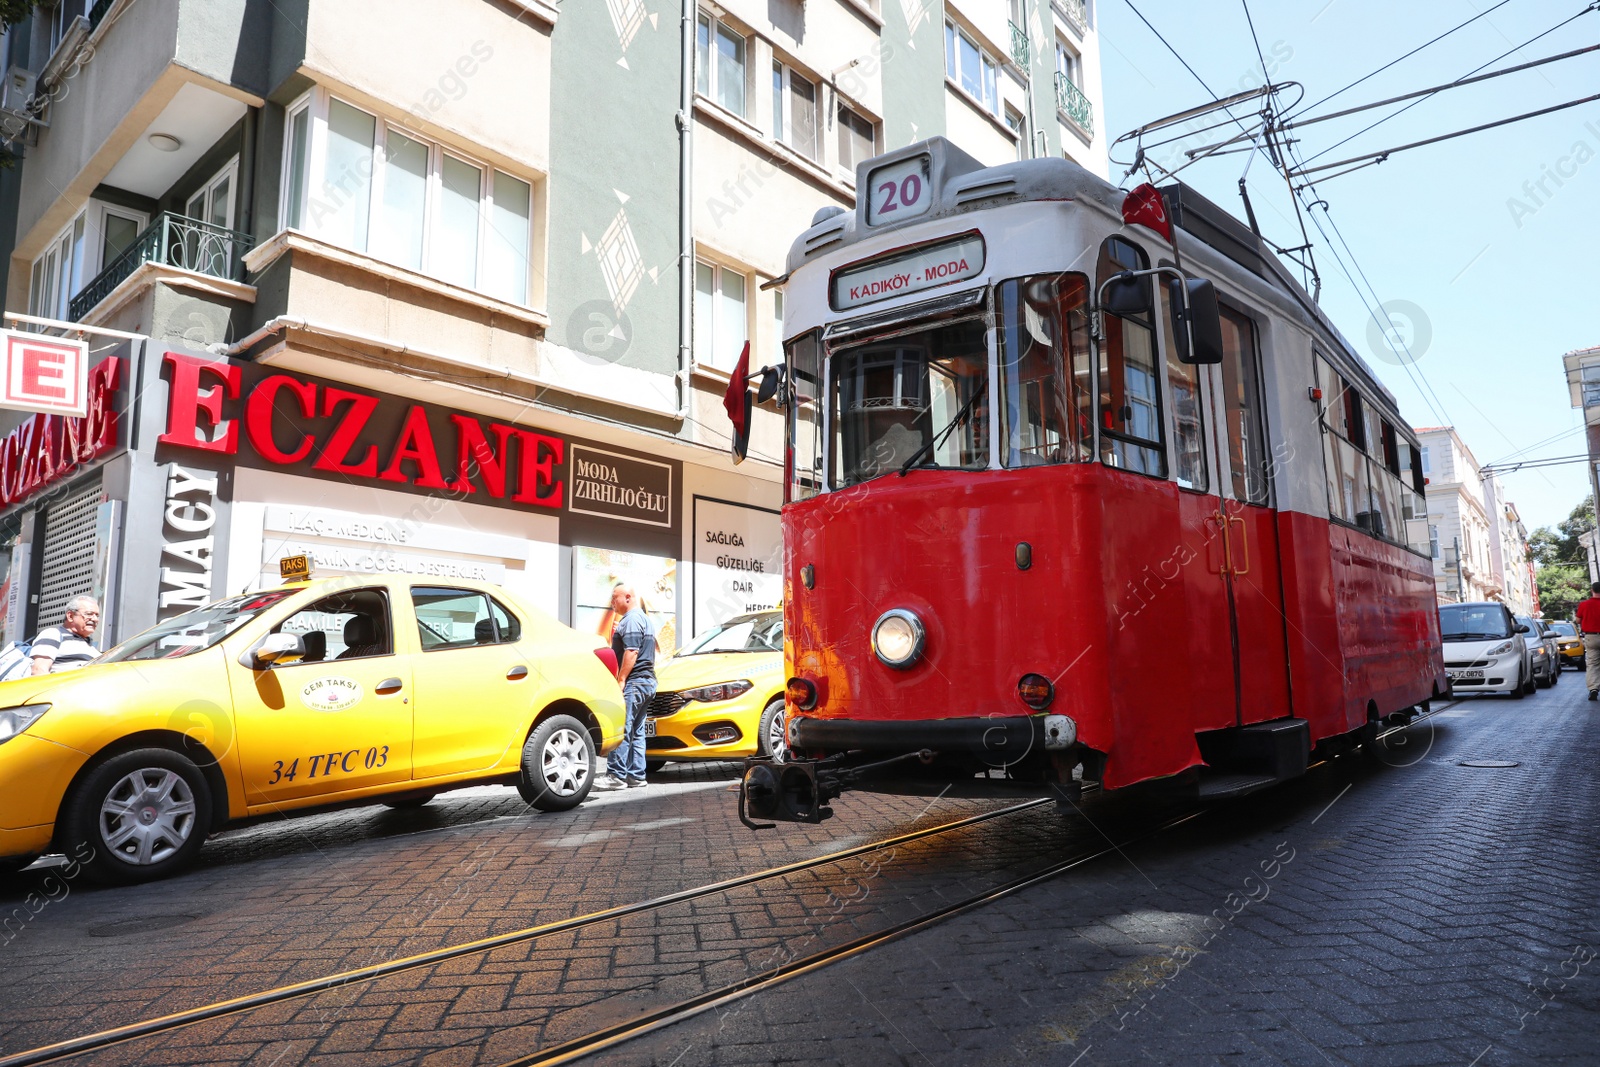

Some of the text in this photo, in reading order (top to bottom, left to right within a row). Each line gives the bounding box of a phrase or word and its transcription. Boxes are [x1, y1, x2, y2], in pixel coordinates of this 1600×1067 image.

[877, 174, 921, 215] 20
[850, 273, 911, 300] KADIKÖY
[925, 258, 969, 282] MODA
[22, 347, 66, 399] E
[158, 351, 564, 509] ECZANE
[577, 459, 619, 483] MODA
[575, 479, 666, 512] ZIRHLIOĞLU
[337, 521, 407, 543] MEDICINE
[706, 531, 744, 547] SAĞLIĞA
[716, 554, 765, 573] GÜZELLİĞE
[732, 579, 754, 593] DAİR
[303, 681, 324, 696] CEM
[268, 745, 390, 785] 34 TFC 03
